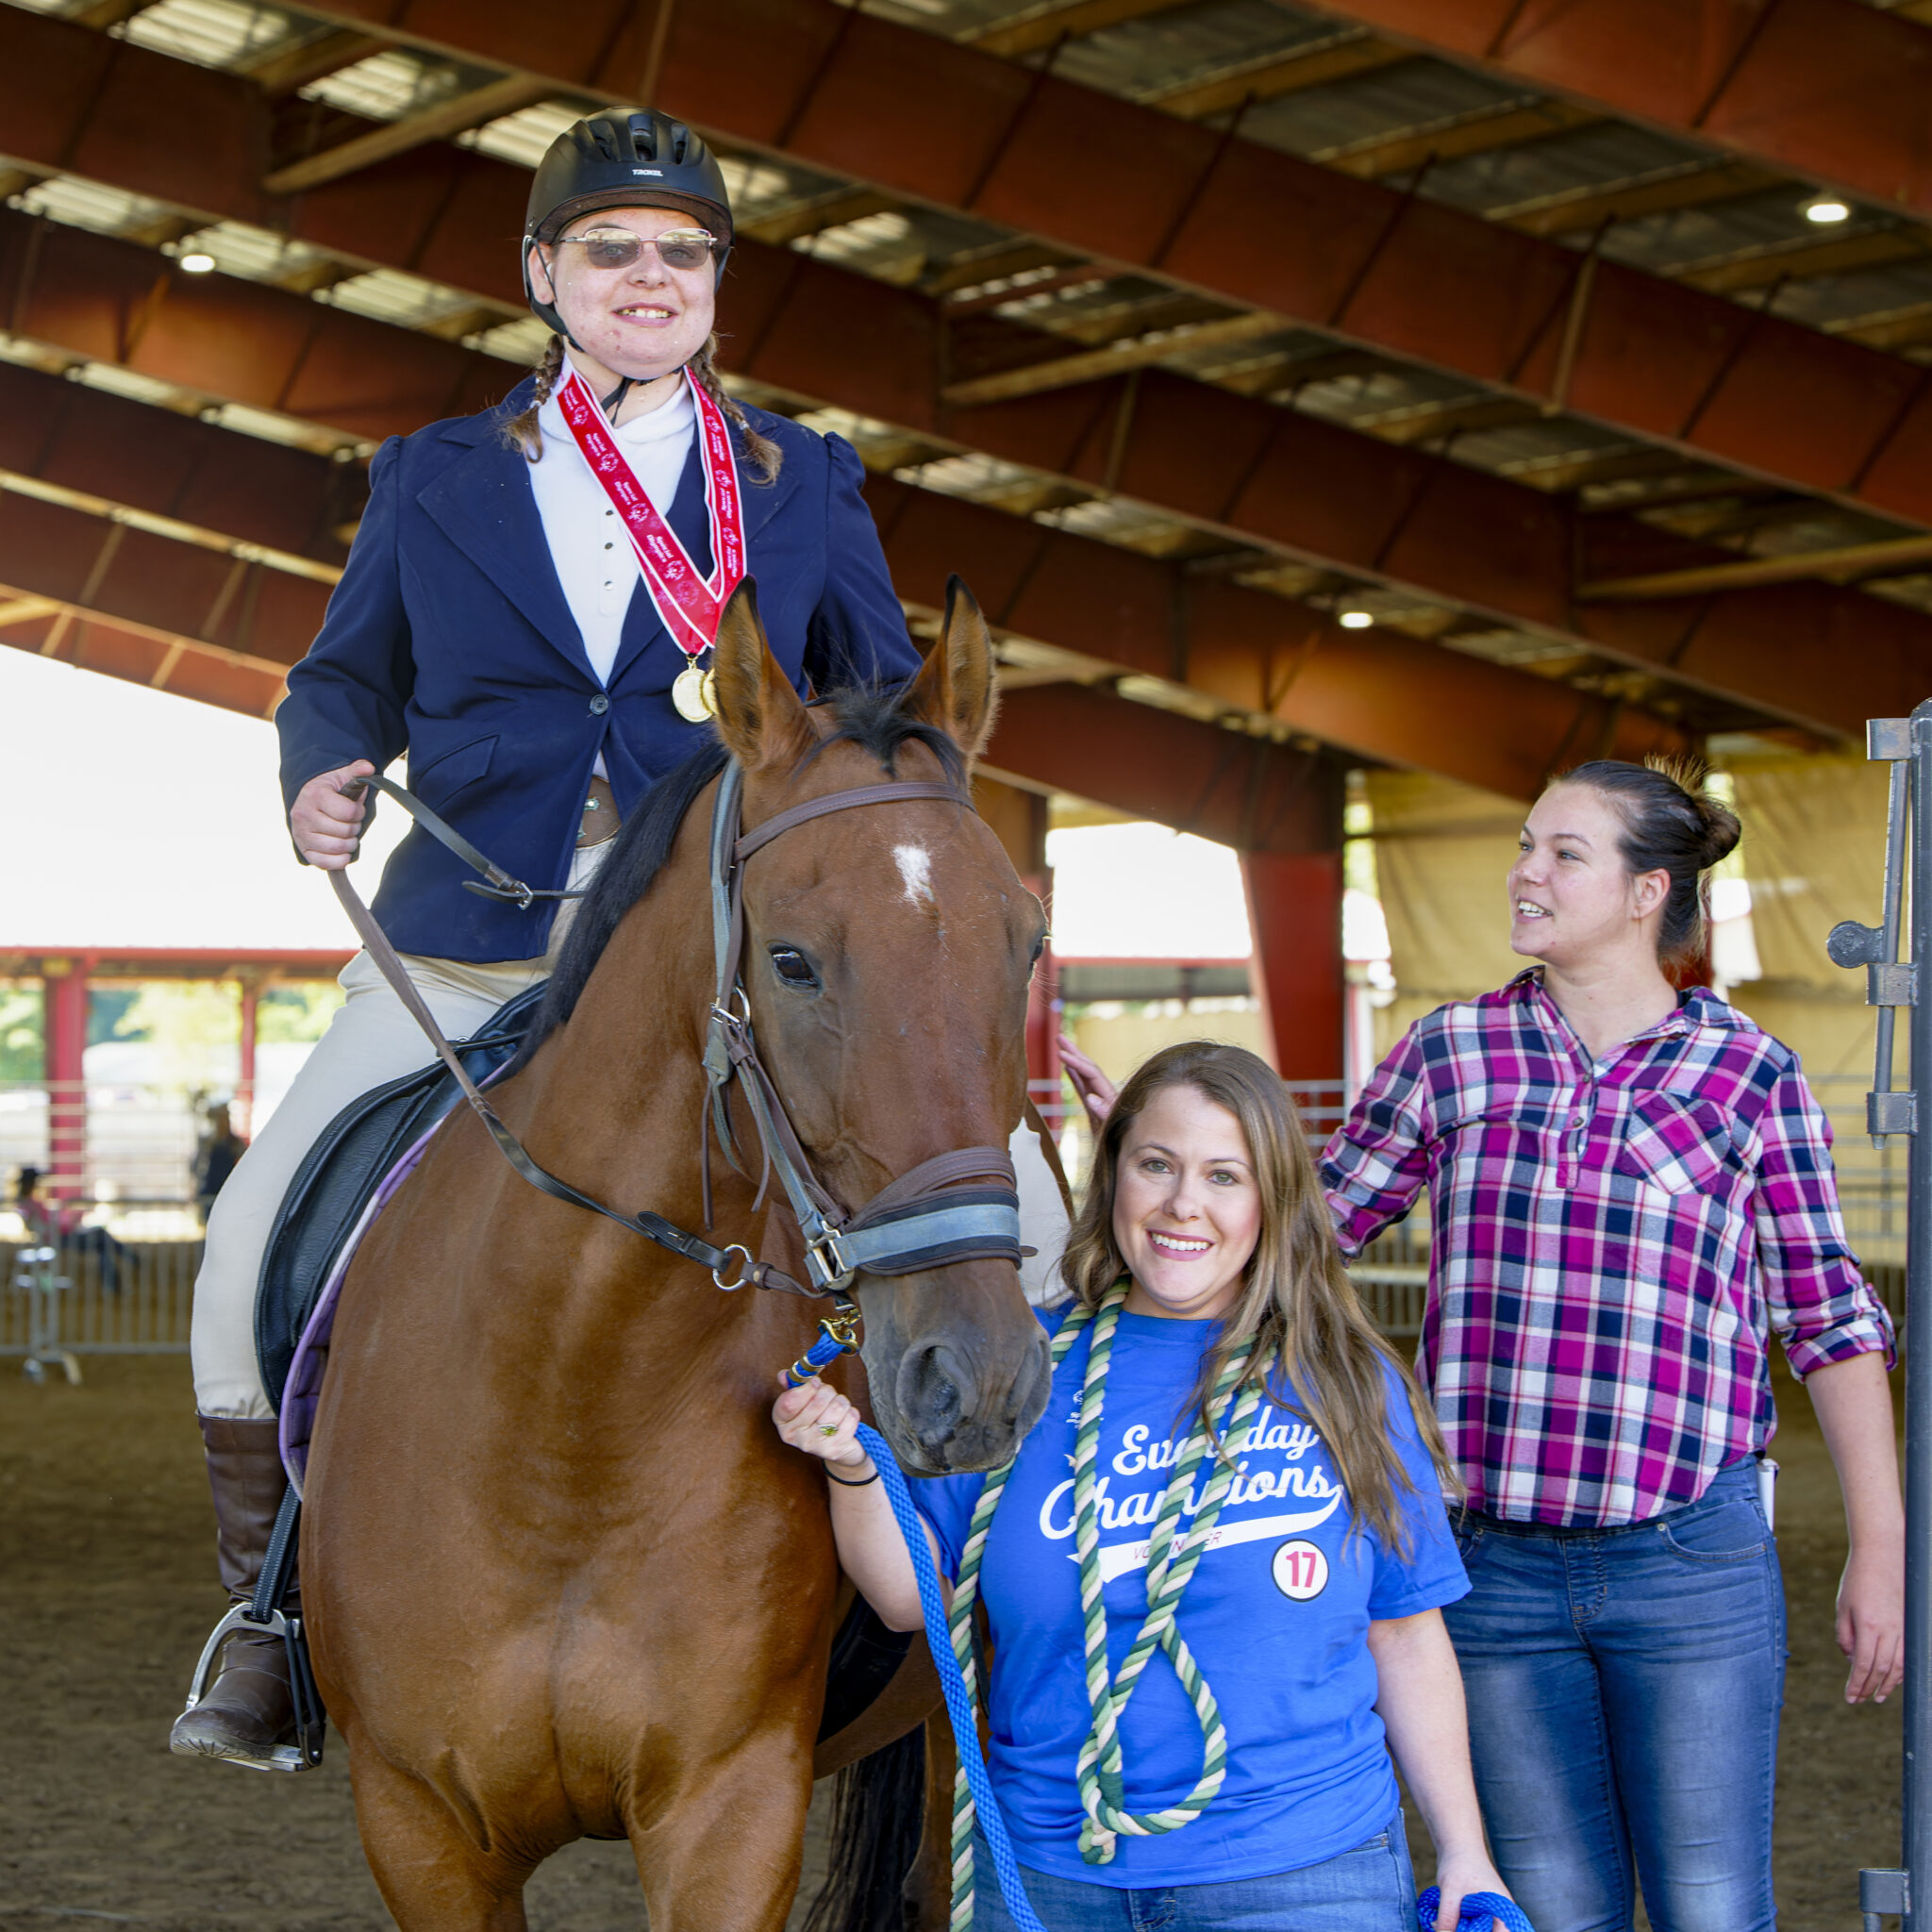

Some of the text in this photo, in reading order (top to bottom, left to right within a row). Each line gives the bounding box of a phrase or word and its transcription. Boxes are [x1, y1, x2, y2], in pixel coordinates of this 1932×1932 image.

[1112, 1405, 1321, 1475] Evday
[1040, 1461, 1332, 1540] Chamions
[1285, 1550, 1317, 1589] 17
